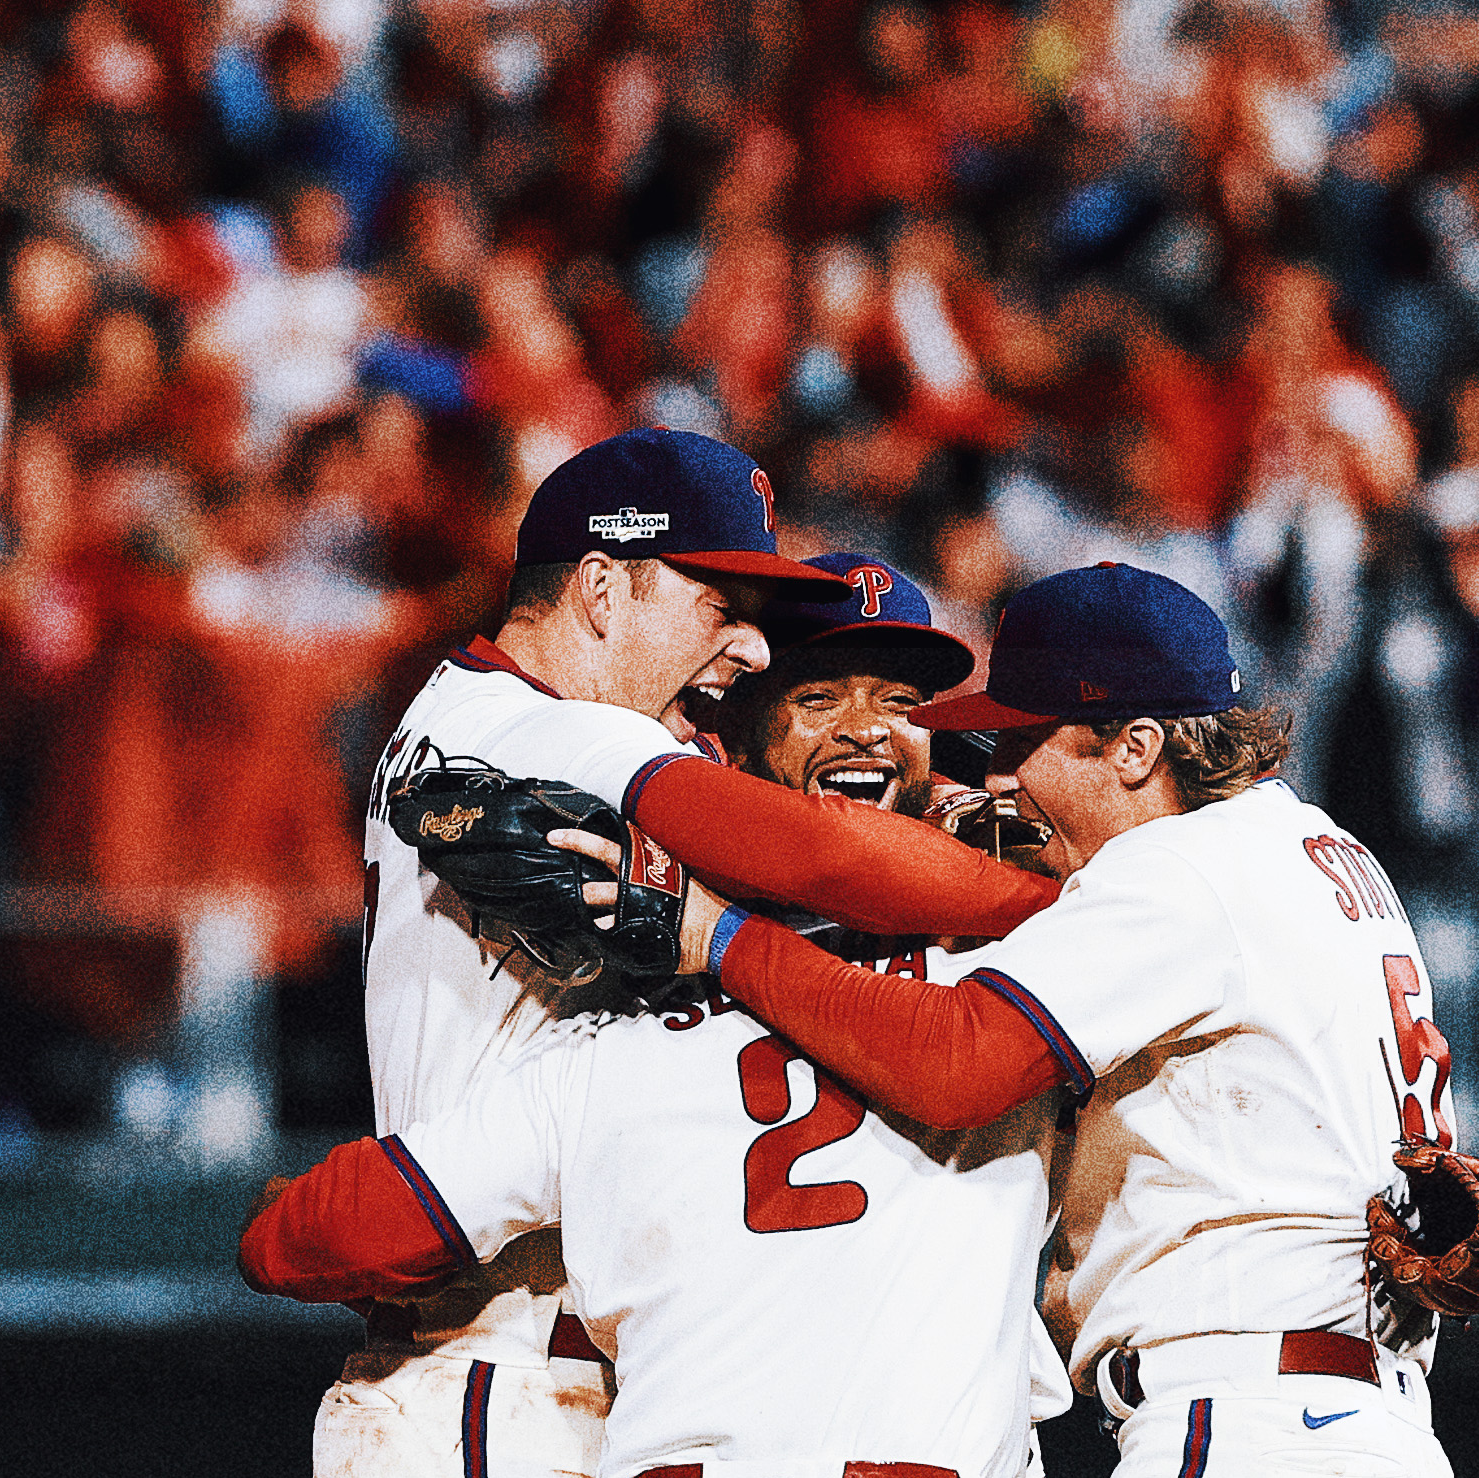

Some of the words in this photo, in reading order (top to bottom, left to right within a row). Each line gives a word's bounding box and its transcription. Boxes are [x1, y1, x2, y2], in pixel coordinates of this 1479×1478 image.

[592, 517, 666, 528] POSTSEASON
[845, 563, 893, 617] P
[419, 804, 485, 836] Rawlings
[737, 1035, 868, 1233] 2
